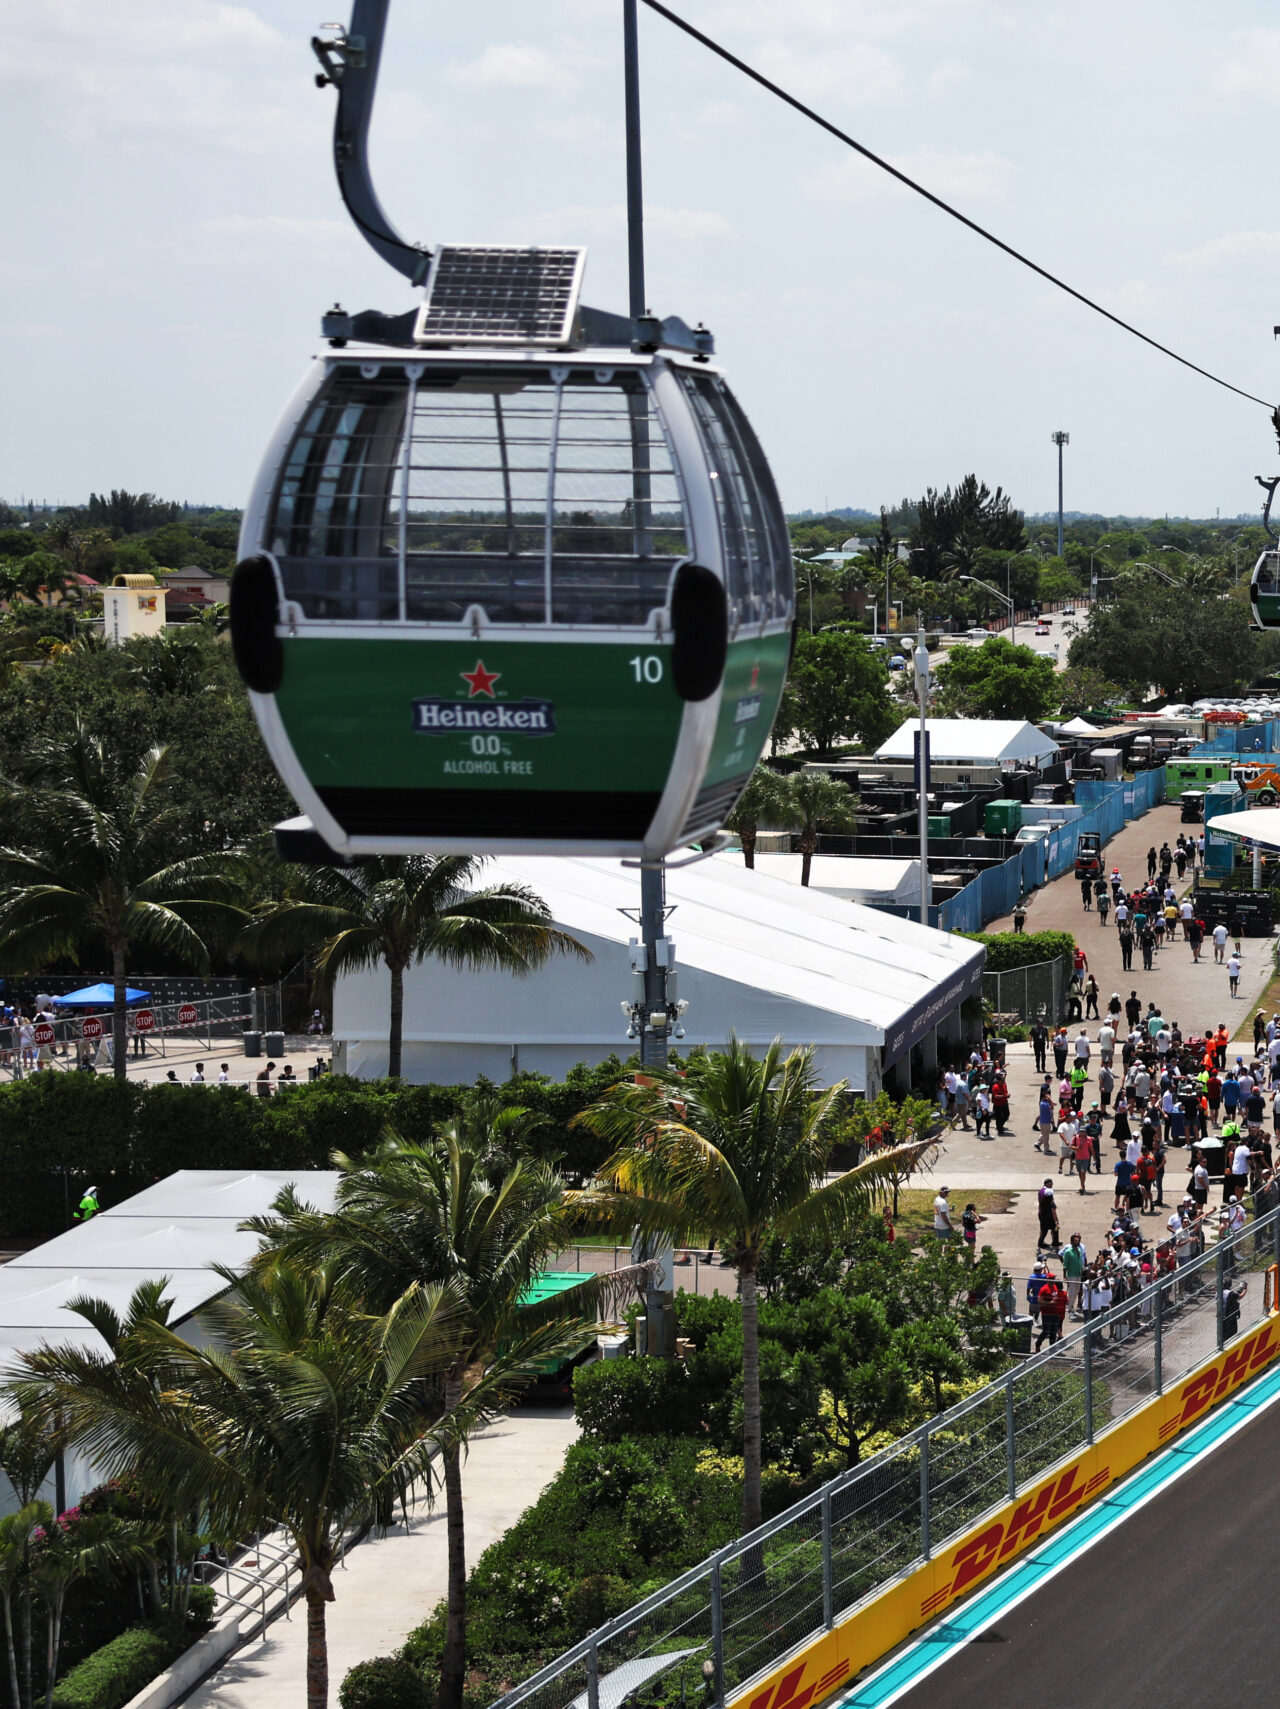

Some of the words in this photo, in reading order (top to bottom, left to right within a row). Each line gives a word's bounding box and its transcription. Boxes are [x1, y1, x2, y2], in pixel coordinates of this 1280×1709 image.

[629, 656, 663, 683] 10
[419, 704, 548, 729] Heineken
[443, 760, 500, 774] ALCOHOL
[503, 761, 534, 775] FREE
[136, 1016, 153, 1026] STOP
[179, 1010, 196, 1020] STOP
[35, 1031, 53, 1041] STOP
[83, 1024, 100, 1034] STOP
[1179, 1324, 1278, 1425] DHL
[949, 1464, 1088, 1596] DHL
